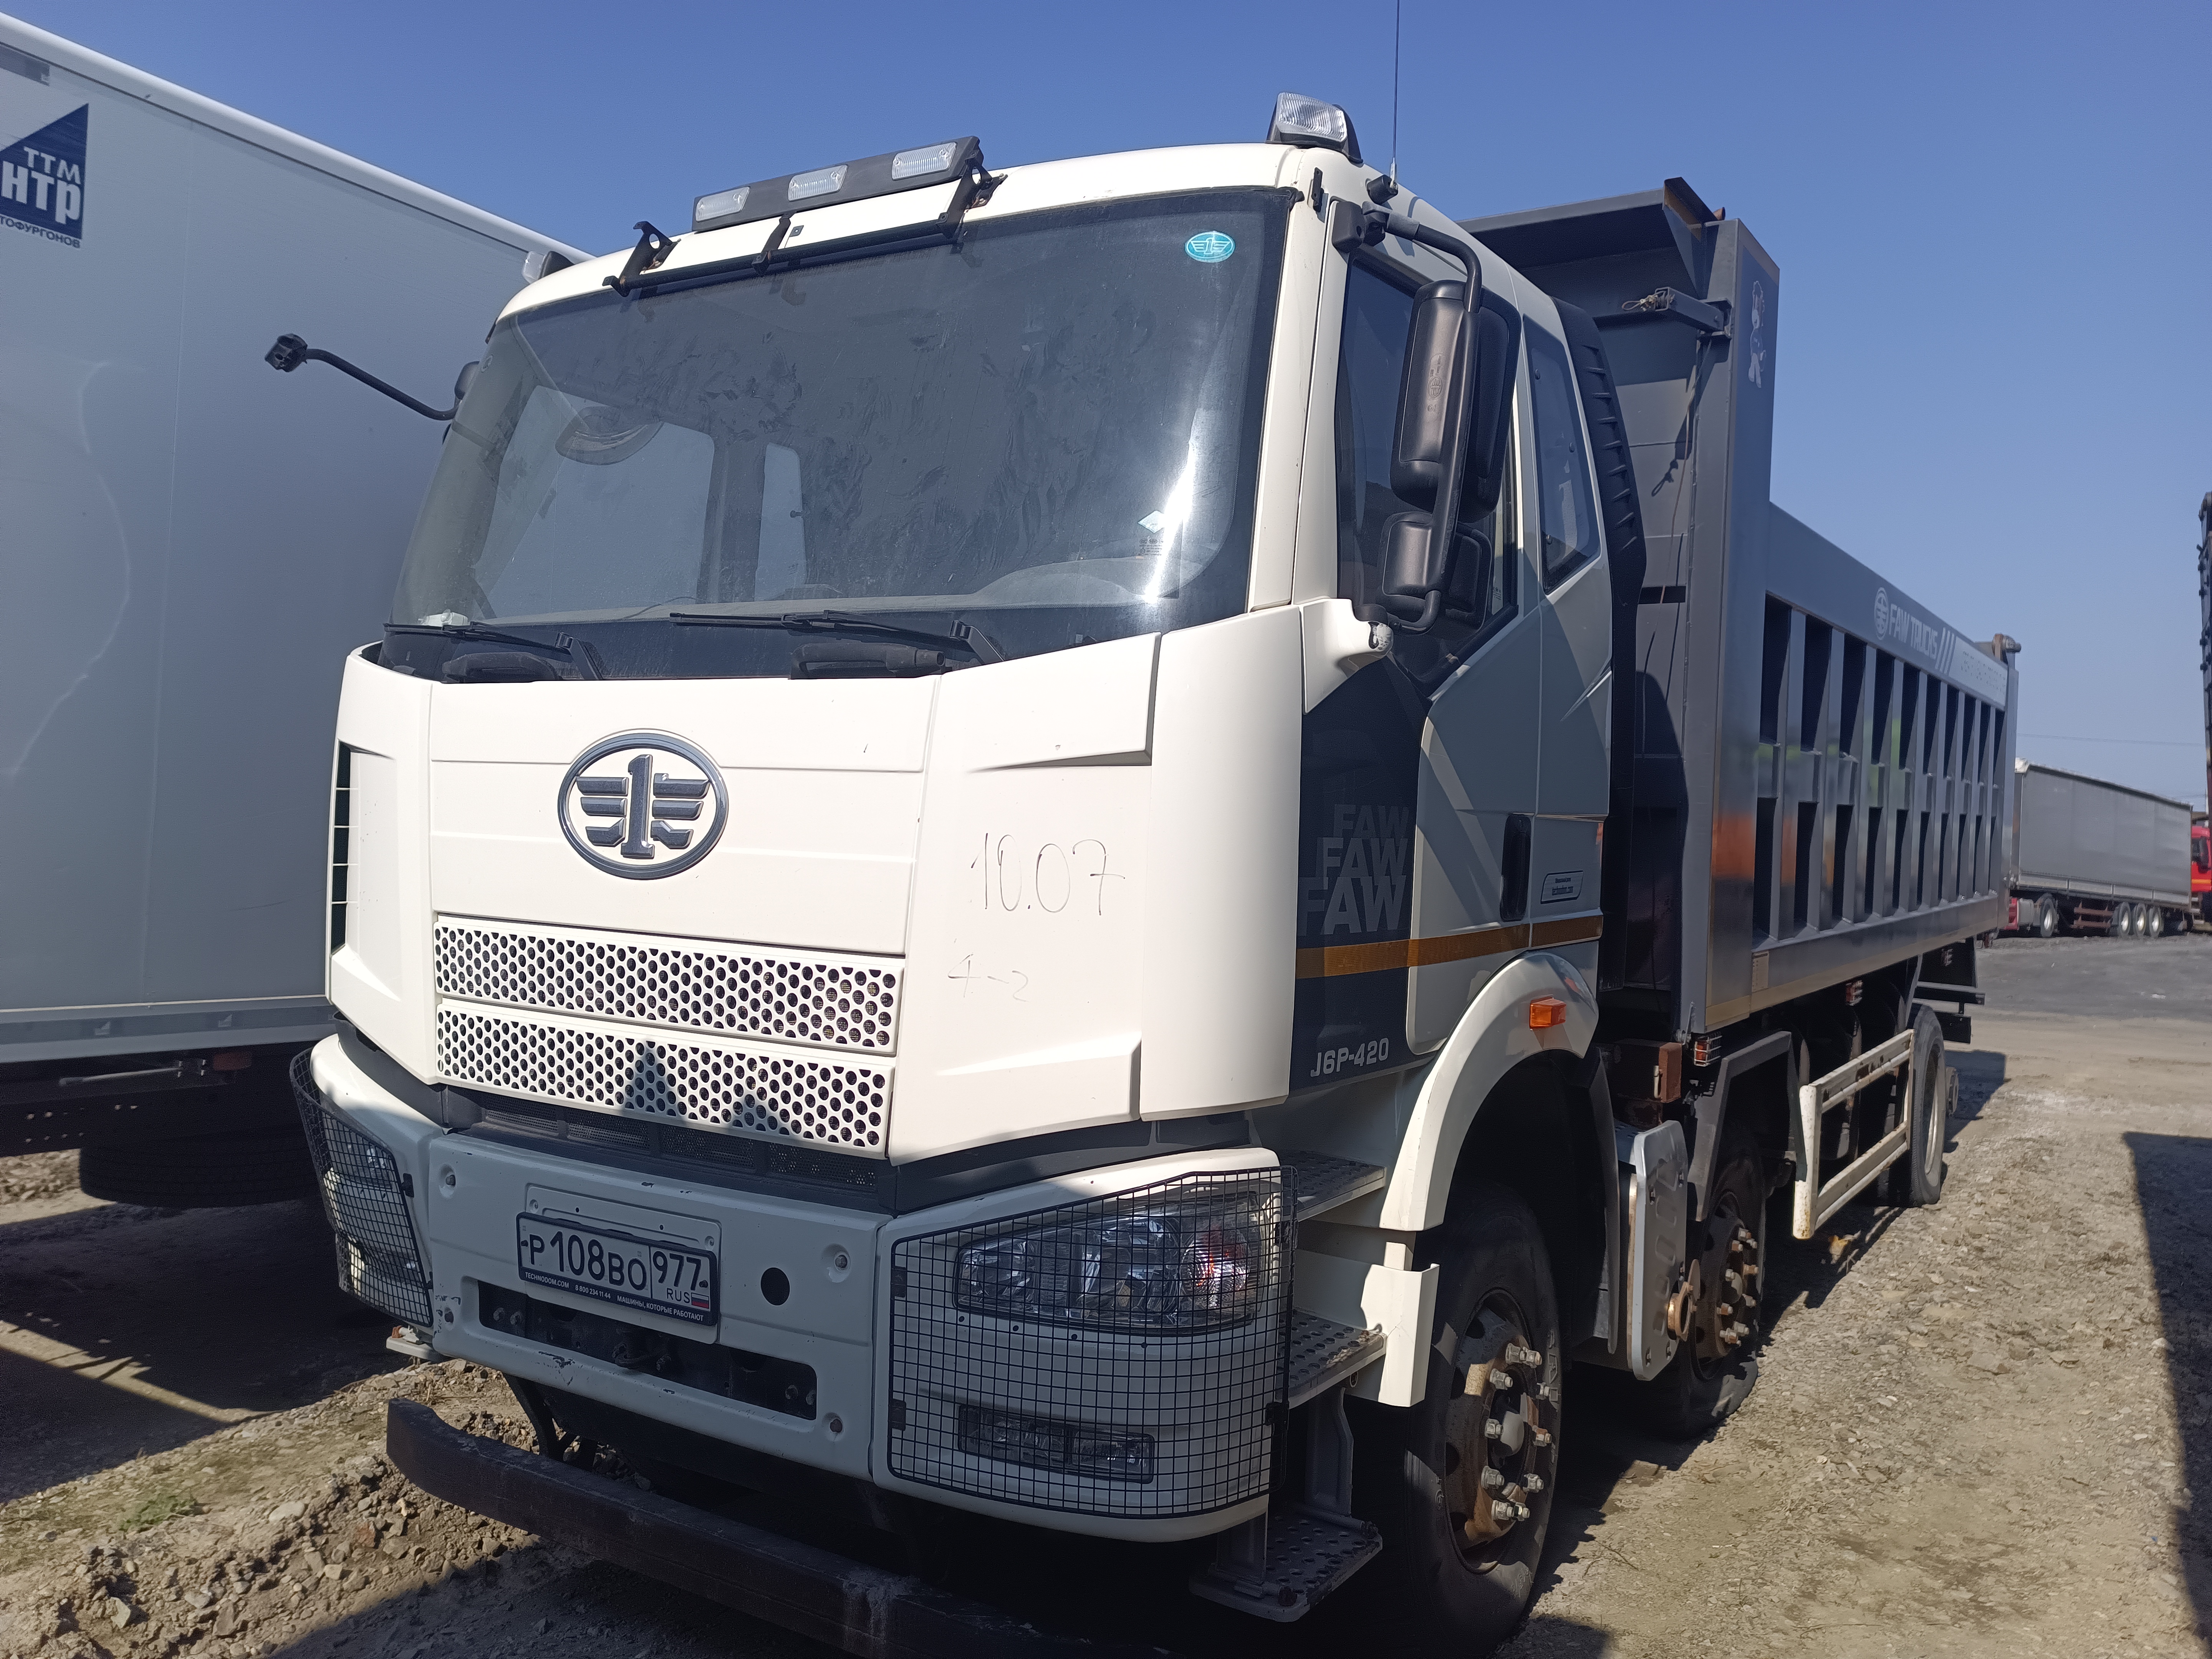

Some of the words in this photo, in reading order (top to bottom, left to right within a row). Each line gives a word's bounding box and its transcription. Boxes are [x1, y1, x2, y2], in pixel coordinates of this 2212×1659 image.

[1889, 603, 1910, 643] FAW
[1333, 804, 1409, 841] FAW
[1316, 837, 1408, 890] FAW
[1297, 875, 1406, 936] FAW
[1310, 1038, 1389, 1077] J6P-420
[525, 1272, 569, 1288] TECHNODOM.COM
[666, 1288, 690, 1303] RUS
[646, 1302, 672, 1314] КОТОРЫЕ
[673, 1309, 704, 1321] РАБОТАЮТ
